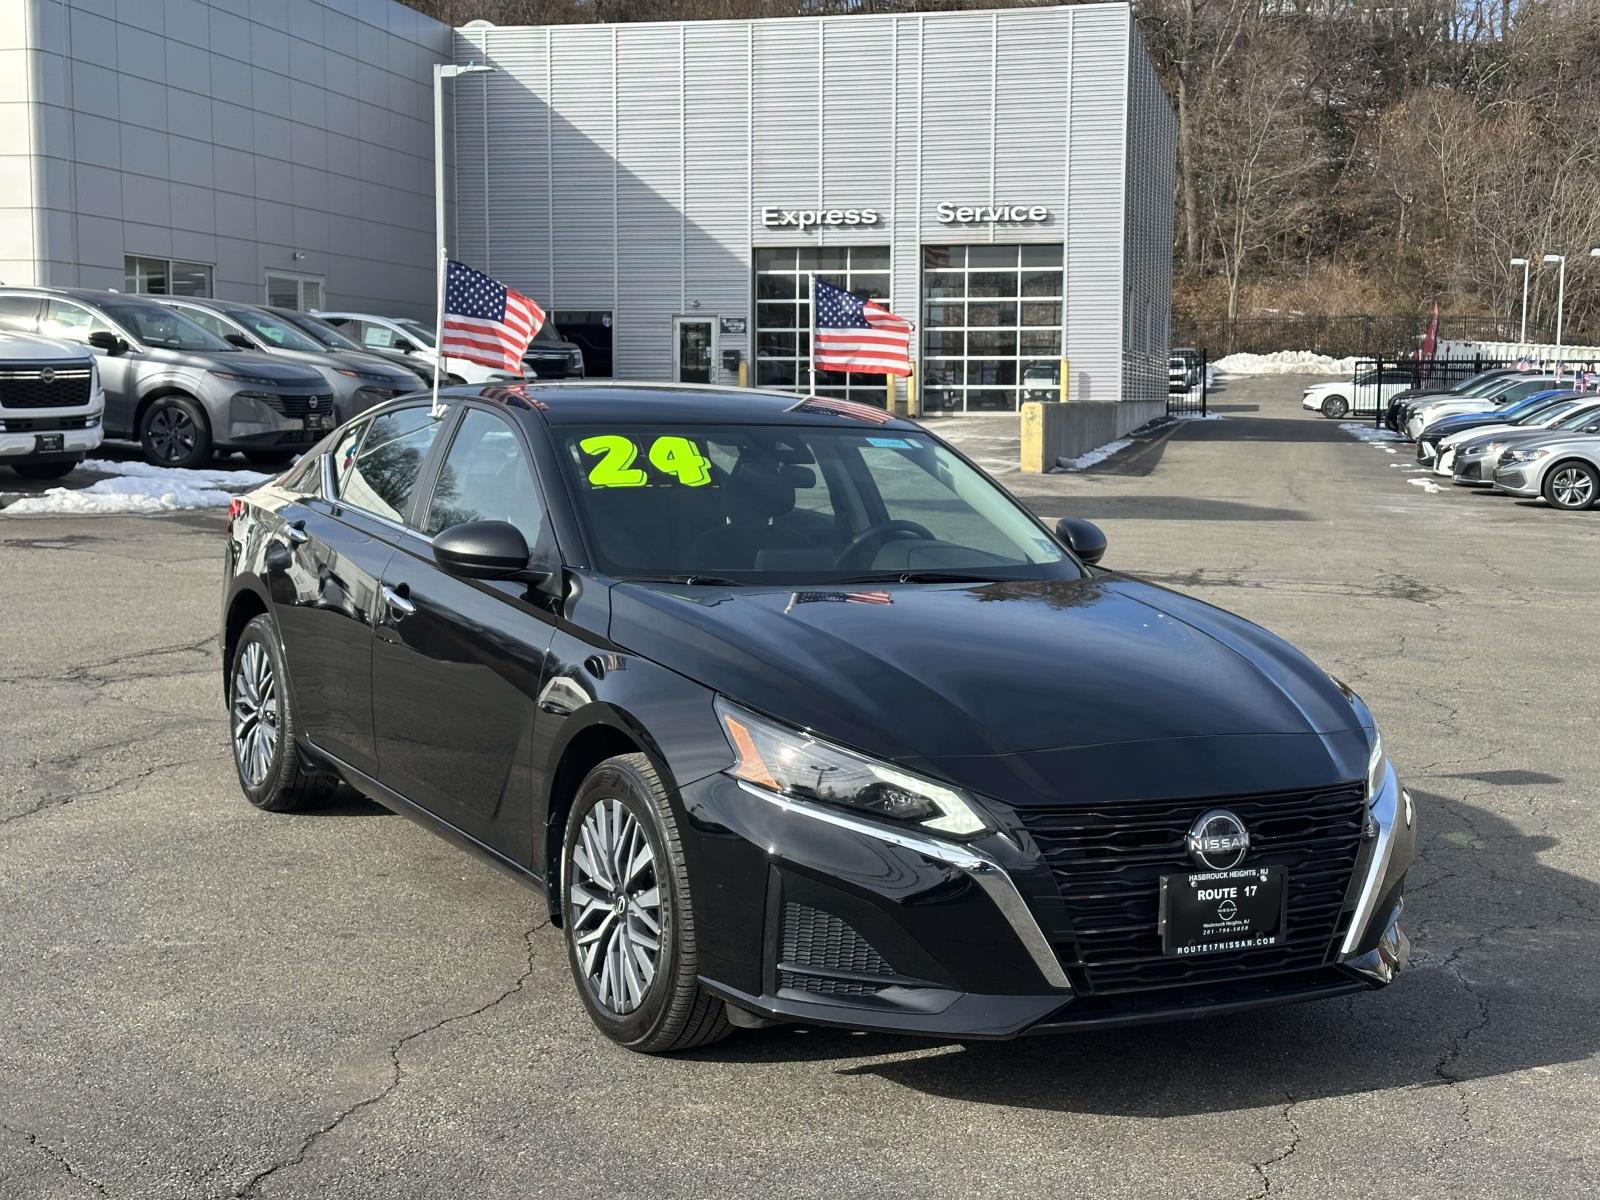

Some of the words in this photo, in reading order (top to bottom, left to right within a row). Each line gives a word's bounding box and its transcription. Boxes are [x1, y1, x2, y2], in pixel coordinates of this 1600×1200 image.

[761, 205, 878, 229] Express
[936, 201, 1048, 223] Service
[580, 434, 712, 488] 24
[1190, 835, 1249, 850] NISSAN
[1188, 872, 1228, 882] HASBROUCK
[1197, 887, 1237, 901] ROUTE
[1244, 885, 1257, 896] 17
[1177, 937, 1275, 955] ROUTE17NISSAN.COM
